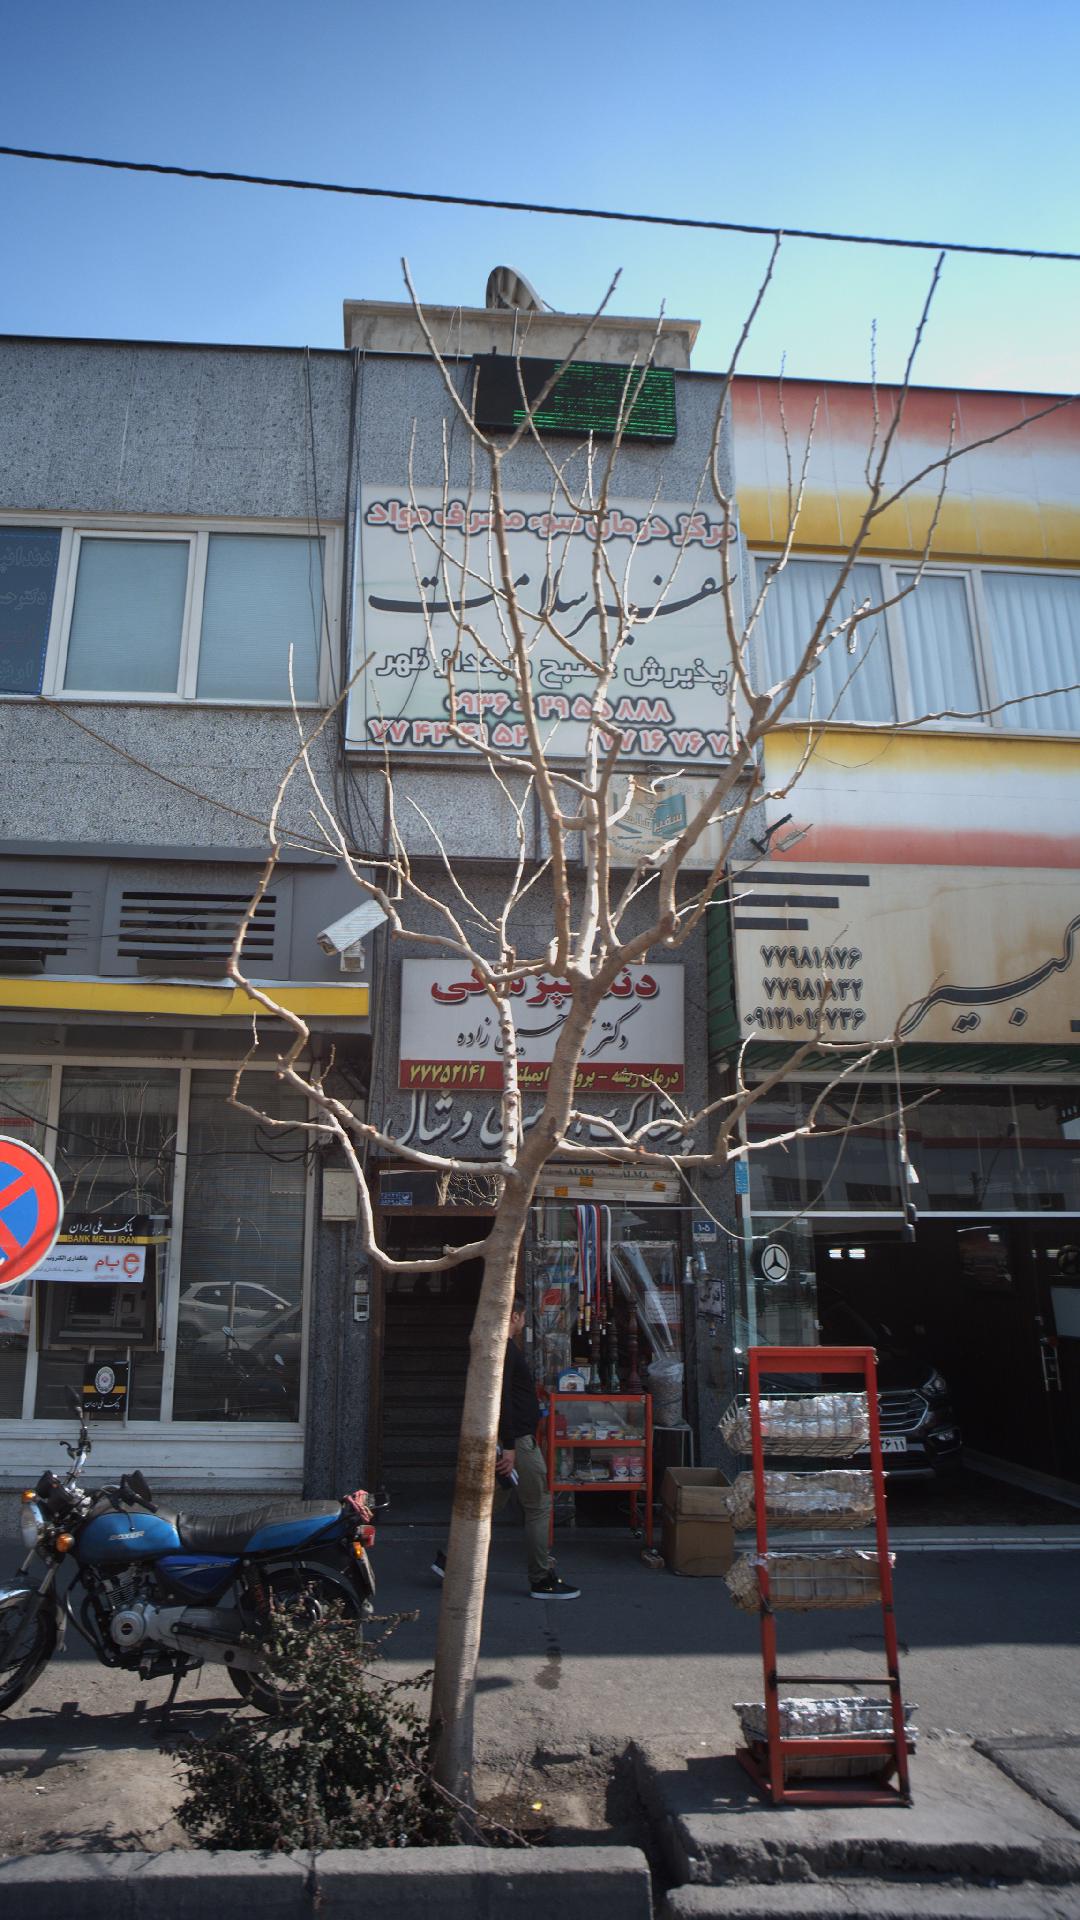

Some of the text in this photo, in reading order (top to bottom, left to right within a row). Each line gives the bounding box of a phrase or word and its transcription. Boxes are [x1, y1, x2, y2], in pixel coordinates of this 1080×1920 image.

[365, 499, 432, 533] مواد
[528, 510, 585, 540] سوء
[584, 509, 670, 545] درمان
[671, 512, 737, 548] مرکز
[376, 647, 430, 678] ظهر
[538, 659, 601, 689] صبح
[760, 945, 862, 969] ۷۷۹۸۱۸۷۶
[457, 1016, 492, 1047] زاده
[587, 1002, 642, 1057] دکتر
[517, 1065, 551, 1087] ایمپلن
[612, 1067, 639, 1088] ریشه
[640, 1067, 679, 1088] درمان
[67, 1234, 137, 1244] BANK MELLI IRAN
[69, 1215, 137, 1235] بانک ملی ایران
